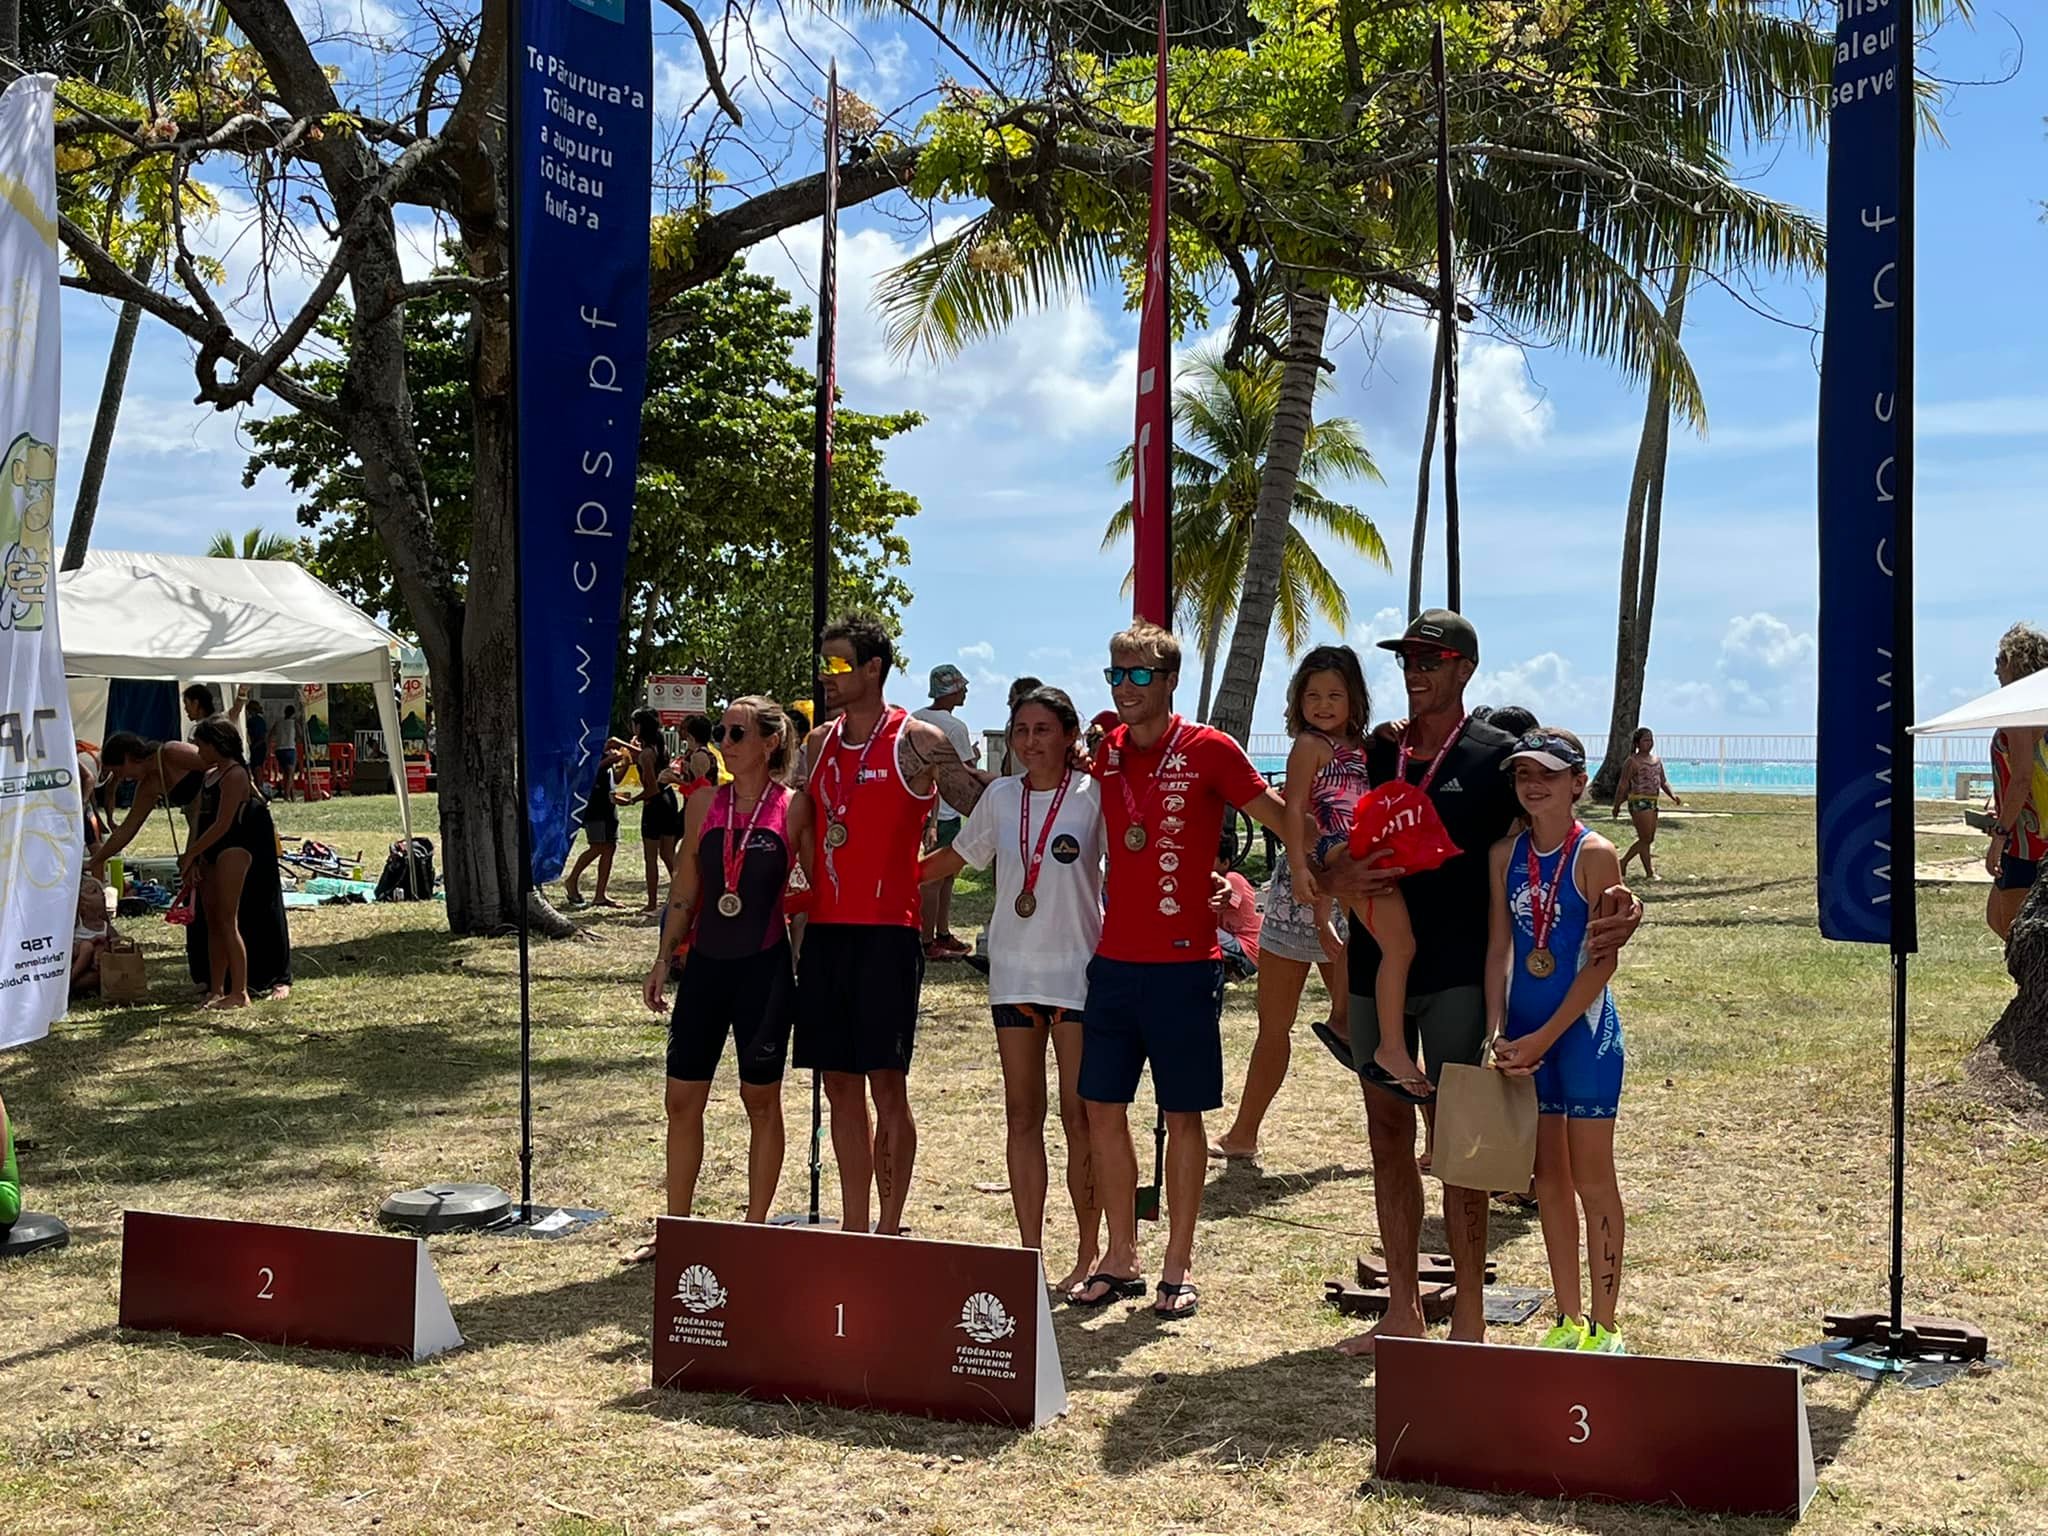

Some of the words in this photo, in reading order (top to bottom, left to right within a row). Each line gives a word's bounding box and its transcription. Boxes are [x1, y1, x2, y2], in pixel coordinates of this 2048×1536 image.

[527, 45, 544, 72] Te
[541, 125, 548, 144] a
[1601, 1215, 1617, 1295] 147
[256, 1266, 274, 1300] 2
[673, 1316, 725, 1328] FÉDÉRATION
[833, 1303, 847, 1338] 1
[675, 1325, 723, 1338] TAHITIENNE
[669, 1334, 681, 1343] DE
[682, 1335, 729, 1348] TRIATHLON
[955, 1345, 1013, 1360] FÉDÉRATION
[958, 1356, 1011, 1369] TAHITIENNE
[951, 1365, 964, 1374] DE
[967, 1367, 1017, 1380] TRIATHLON
[1568, 1404, 1591, 1444] 3
